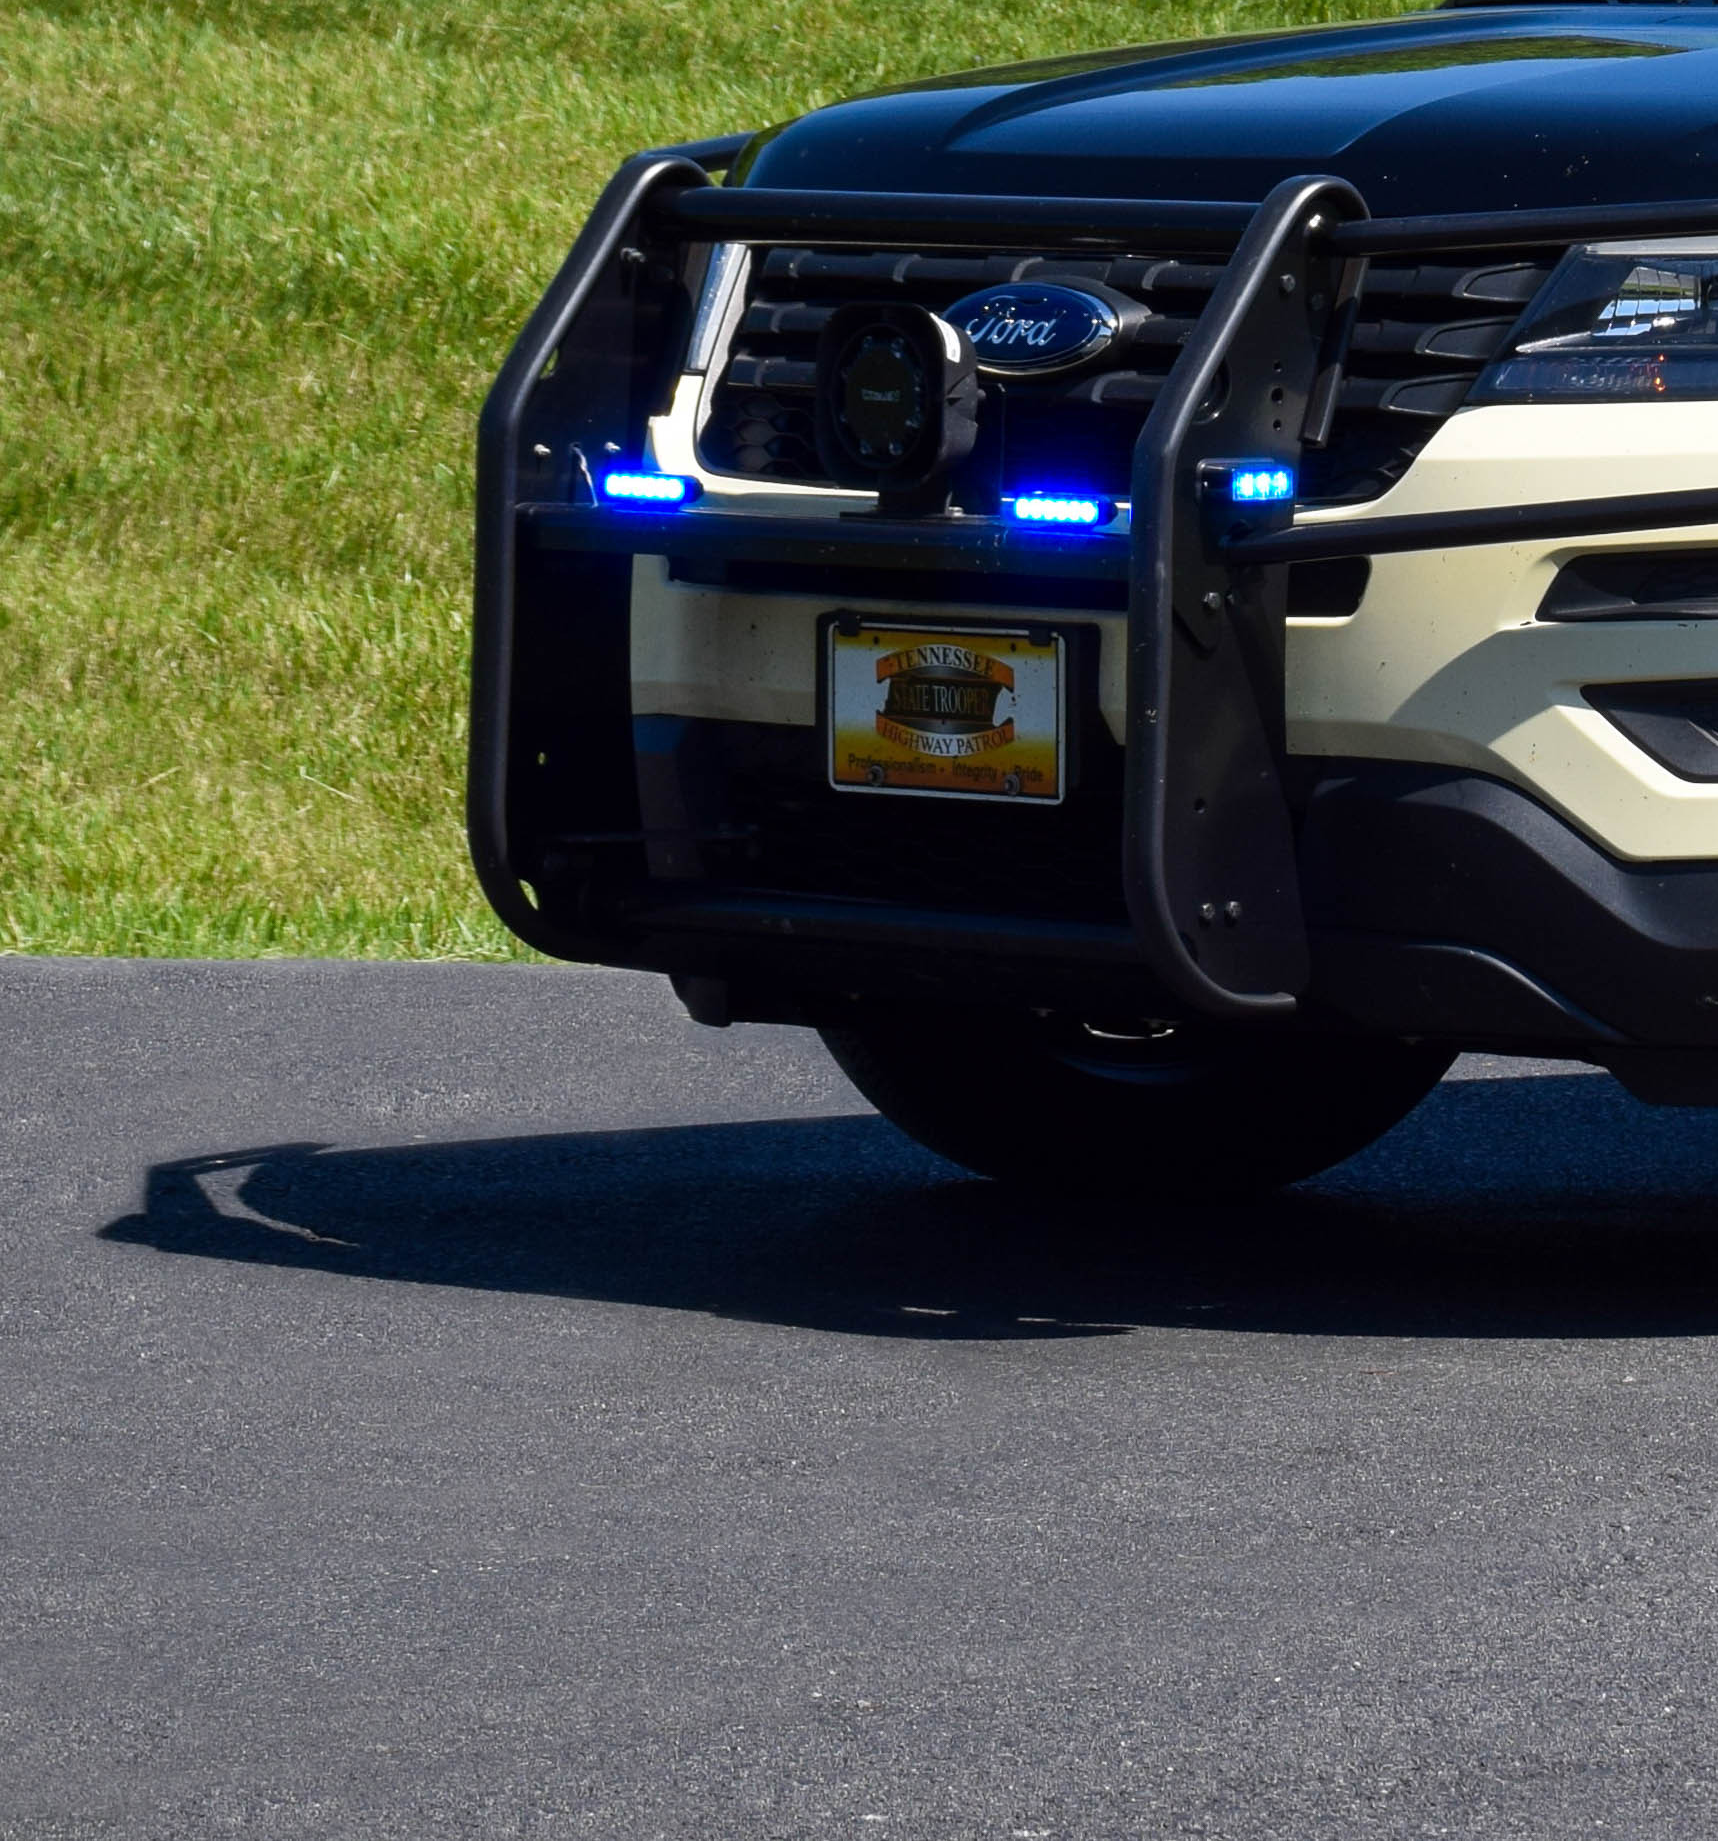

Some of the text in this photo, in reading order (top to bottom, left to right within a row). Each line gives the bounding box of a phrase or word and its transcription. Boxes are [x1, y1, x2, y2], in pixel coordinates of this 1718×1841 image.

[964, 297, 1063, 347] Ford
[895, 645, 994, 678] TENNESSEE
[892, 683, 993, 717] STATE TROOPER
[881, 724, 1011, 756] HIGHWAY PATROL
